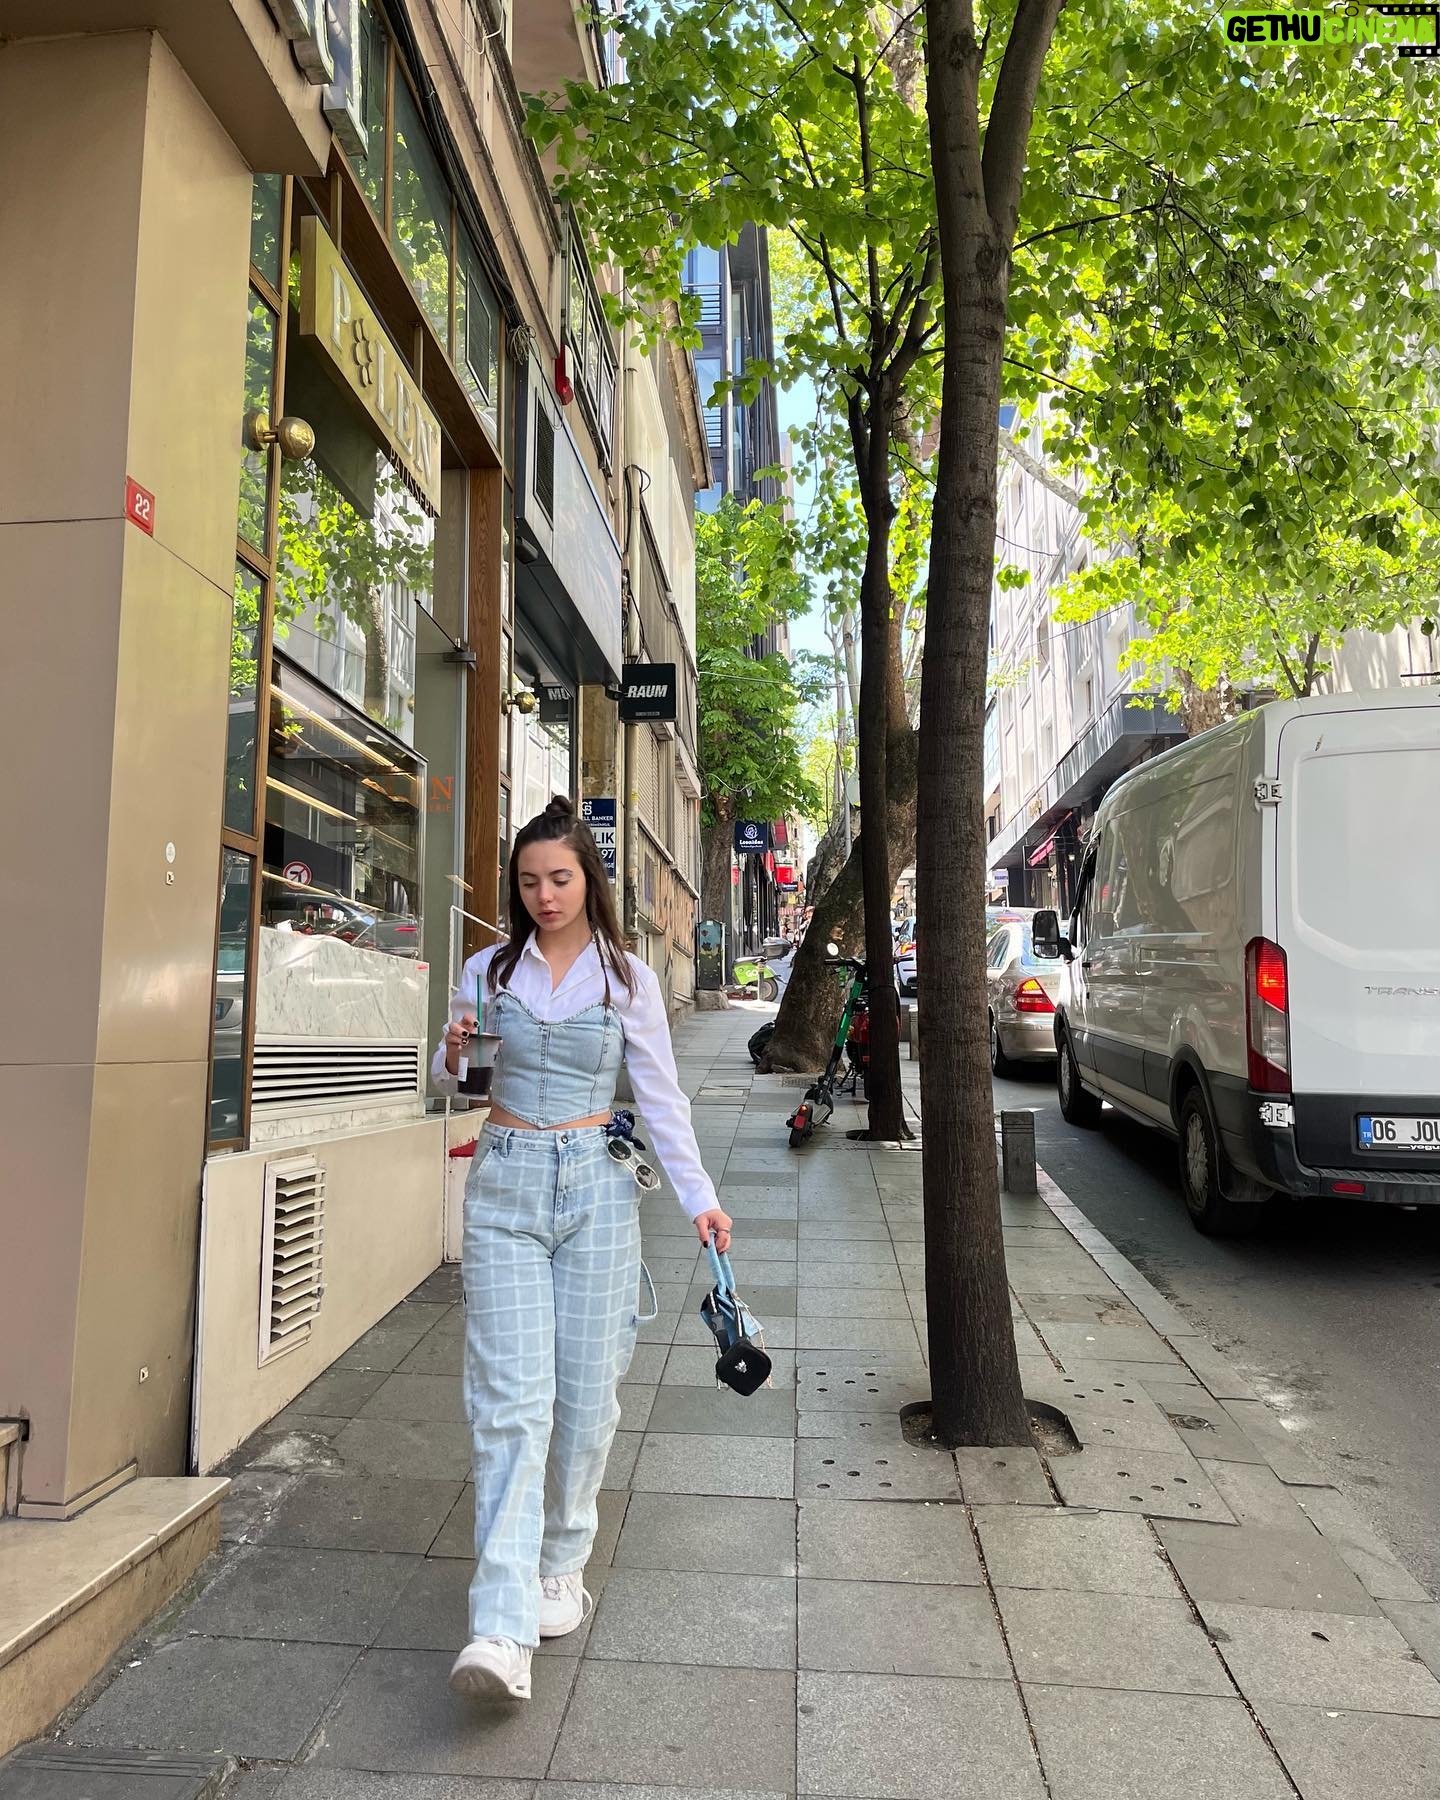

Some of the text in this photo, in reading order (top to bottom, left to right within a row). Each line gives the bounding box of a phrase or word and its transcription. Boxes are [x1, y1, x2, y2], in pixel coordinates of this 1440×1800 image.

[135, 493, 150, 521] 22
[627, 685, 668, 698] RAUM
[1372, 1119, 1397, 1141] 06
